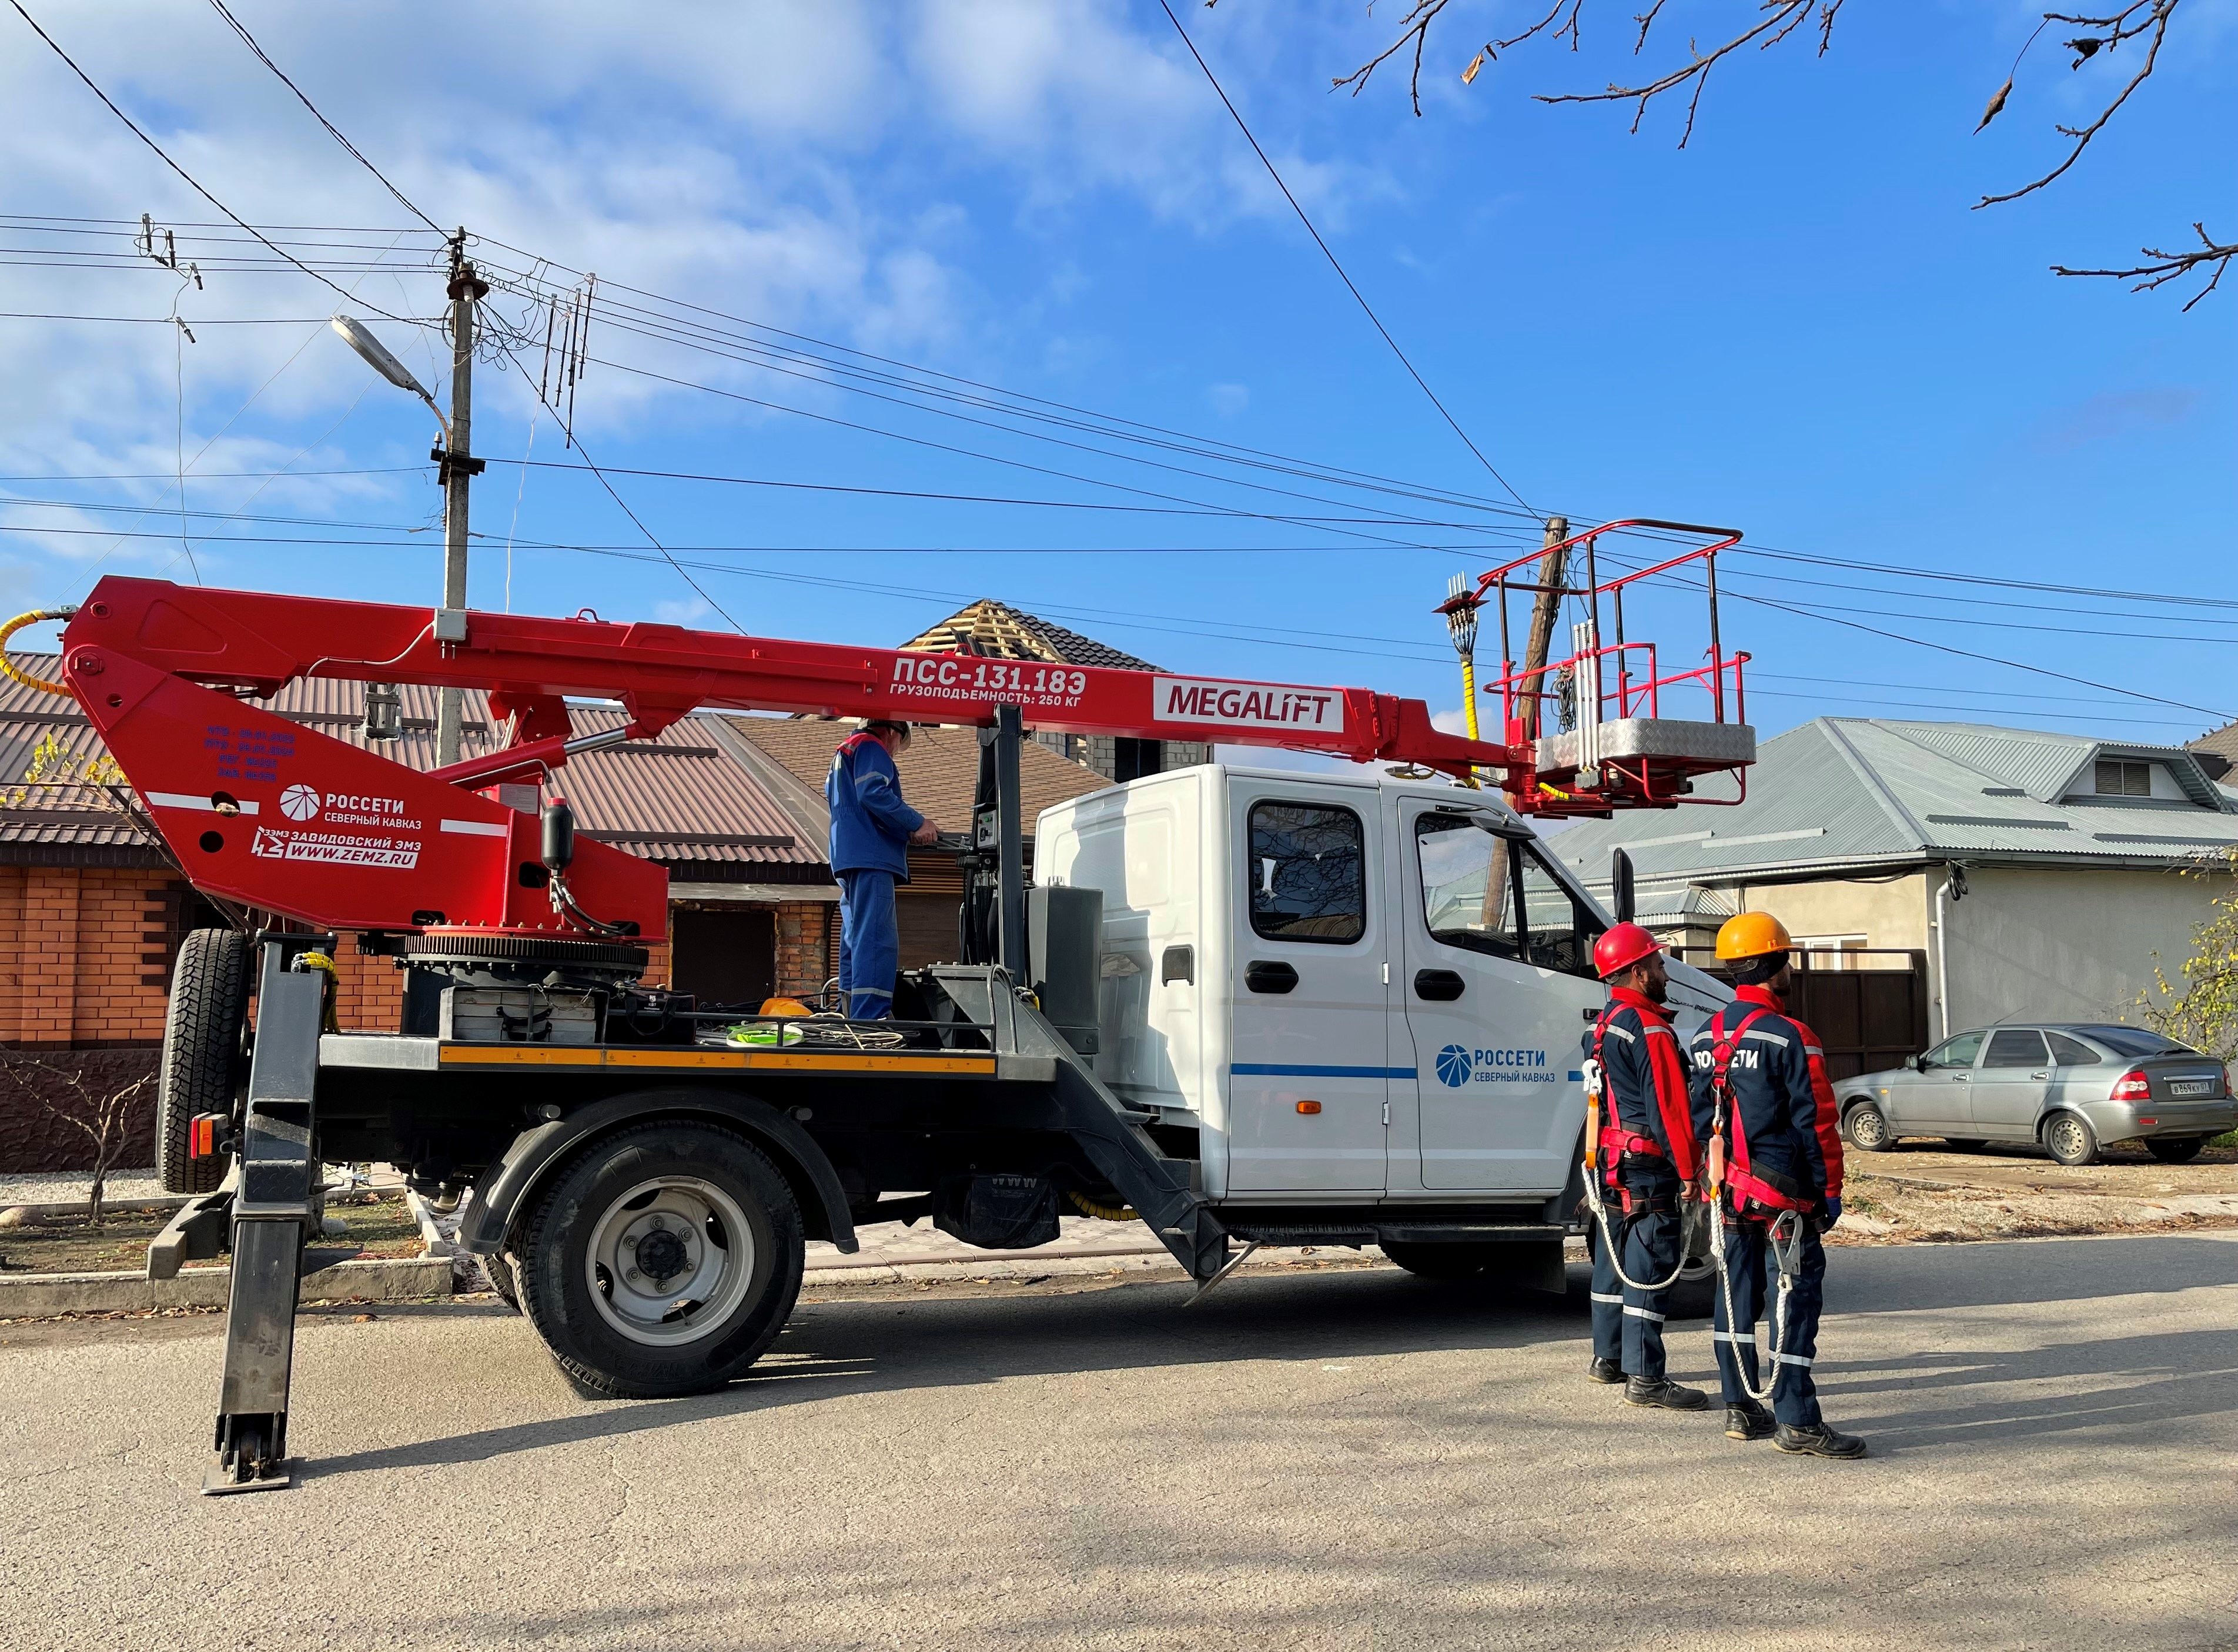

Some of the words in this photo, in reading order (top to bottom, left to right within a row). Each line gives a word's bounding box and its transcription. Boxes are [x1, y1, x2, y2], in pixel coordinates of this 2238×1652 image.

[894, 658, 1086, 694] ПСС-131.18Э
[890, 683, 1035, 704] ГРУЗОПОДЪЕМНОСТЬ:
[1039, 695, 1061, 705] 250
[1065, 697, 1081, 707] КГ
[326, 794, 404, 814] РОССЕТИ
[325, 812, 379, 825] СЕВЕРНЫЙ
[383, 818, 421, 830] КАВКАЗ
[291, 832, 392, 848] ЗАВИДОВСКИЙ
[395, 841, 421, 851] ЭМЗ
[292, 845, 413, 865] WWW.ZEMZ.RU
[1474, 1049, 1545, 1066] РОССЕТИ
[1694, 1049, 1758, 1069] РОЕТИ
[1474, 1070, 1520, 1082] СЕВЕРНЫЙ
[1523, 1073, 1555, 1082] КАВКАЗ
